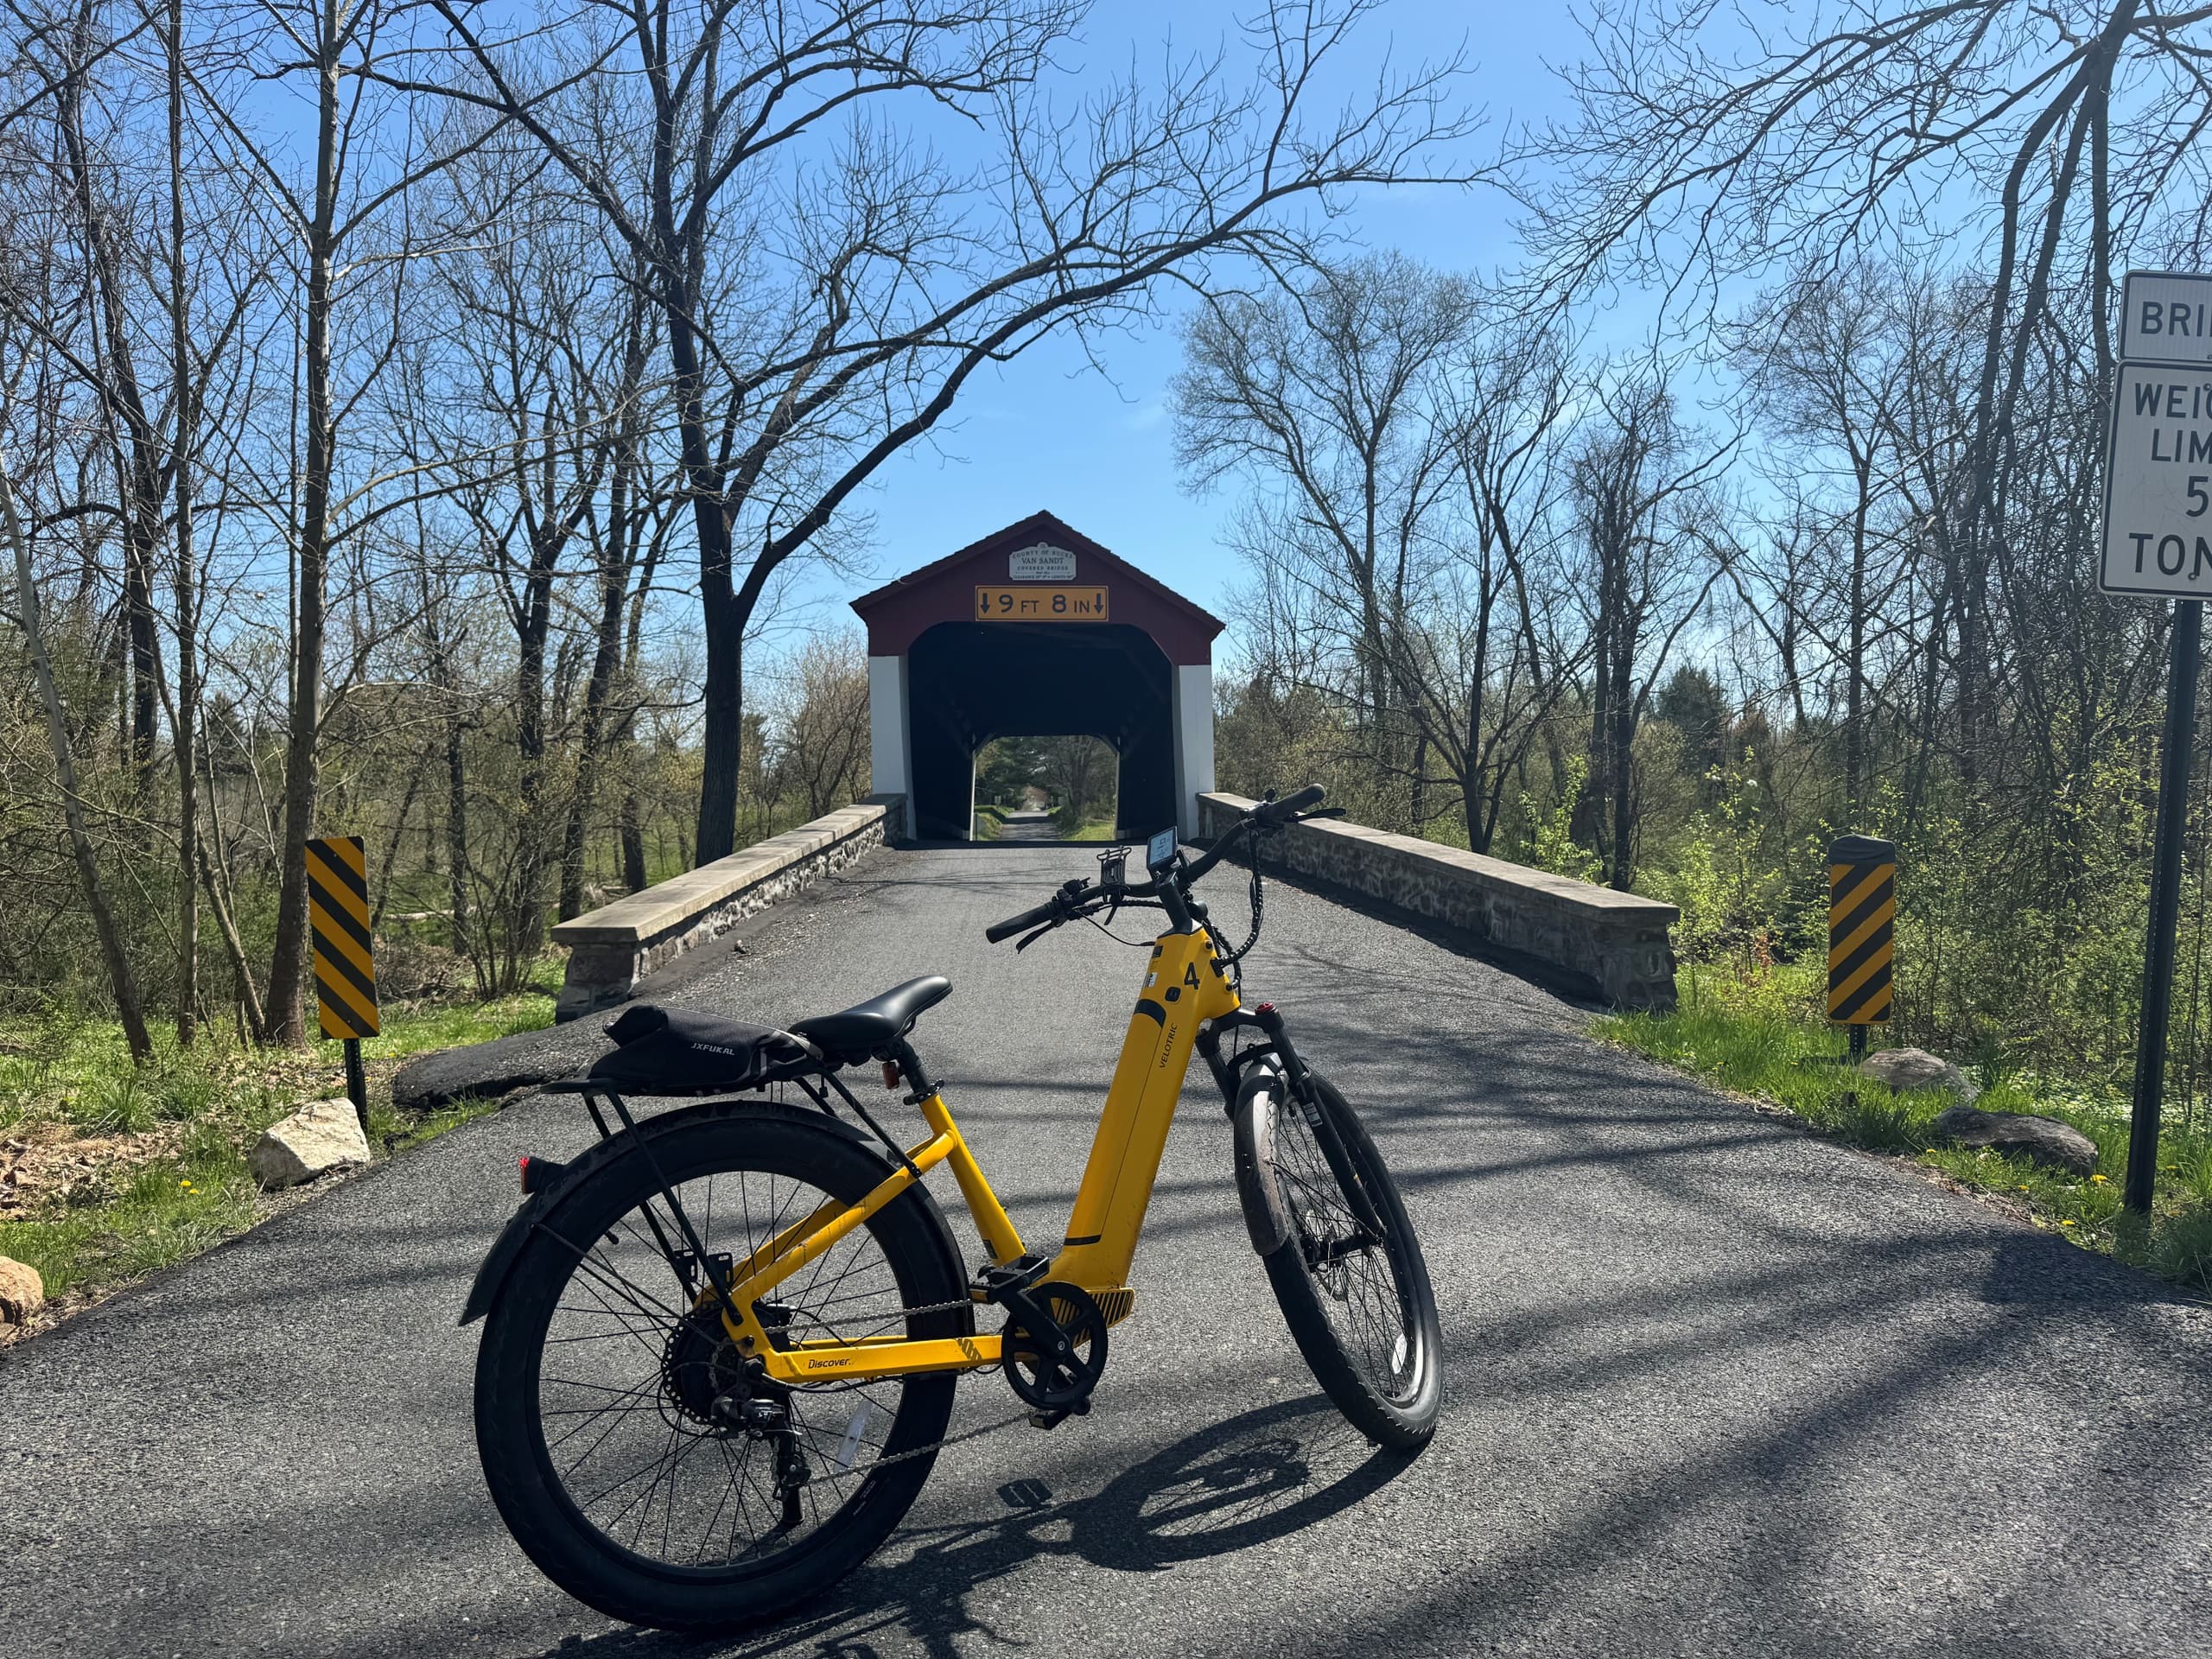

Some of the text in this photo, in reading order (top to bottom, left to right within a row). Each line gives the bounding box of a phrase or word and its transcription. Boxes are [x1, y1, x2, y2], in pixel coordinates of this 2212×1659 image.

[2140, 301, 2212, 337] BRI
[2186, 475, 2209, 518] 5
[999, 594, 1090, 613] 9 FT 8 IN
[1184, 962, 1200, 989] 4
[1159, 1023, 1178, 1068] VELOTRIC
